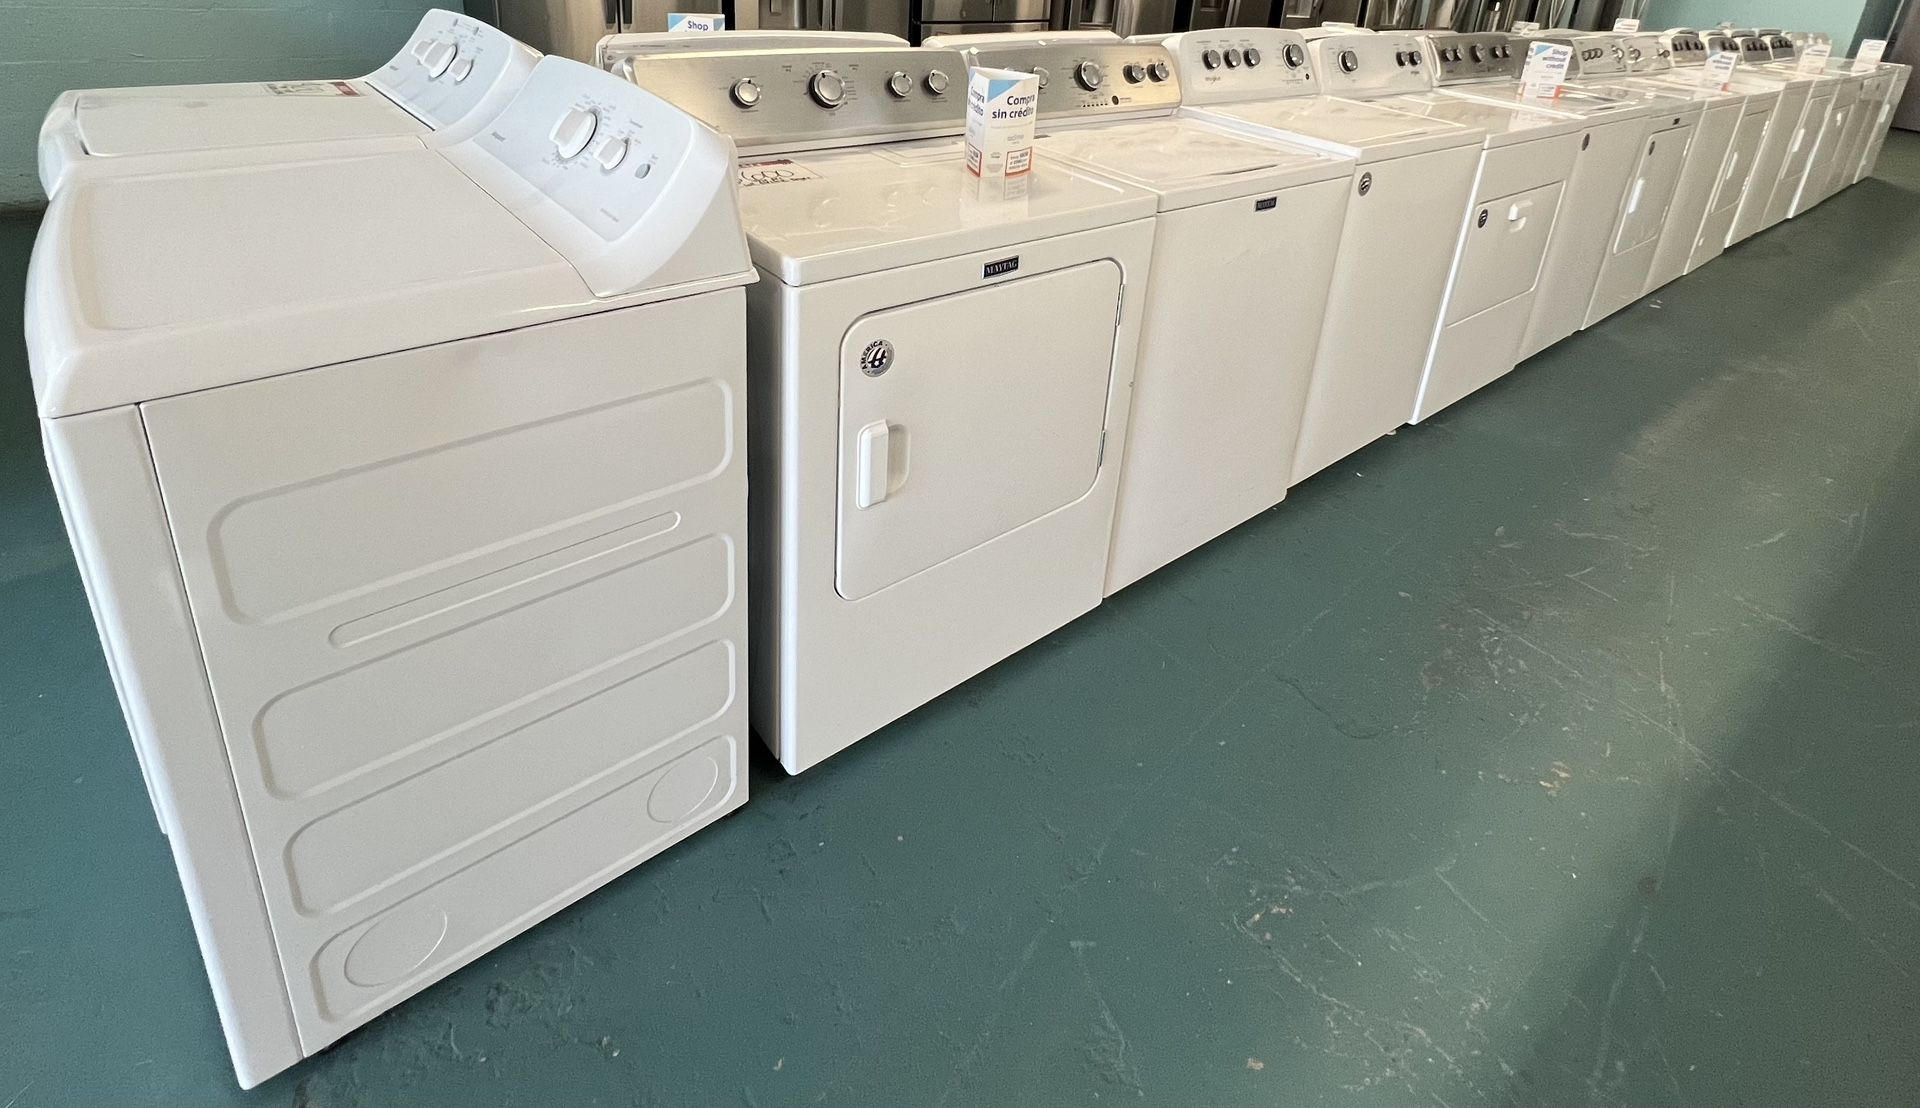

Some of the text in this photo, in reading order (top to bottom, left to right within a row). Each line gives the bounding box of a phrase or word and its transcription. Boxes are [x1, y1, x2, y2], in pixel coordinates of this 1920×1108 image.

[688, 20, 708, 31] Shop
[992, 108, 1007, 119] sin
[986, 260, 1017, 274] MAYTAG
